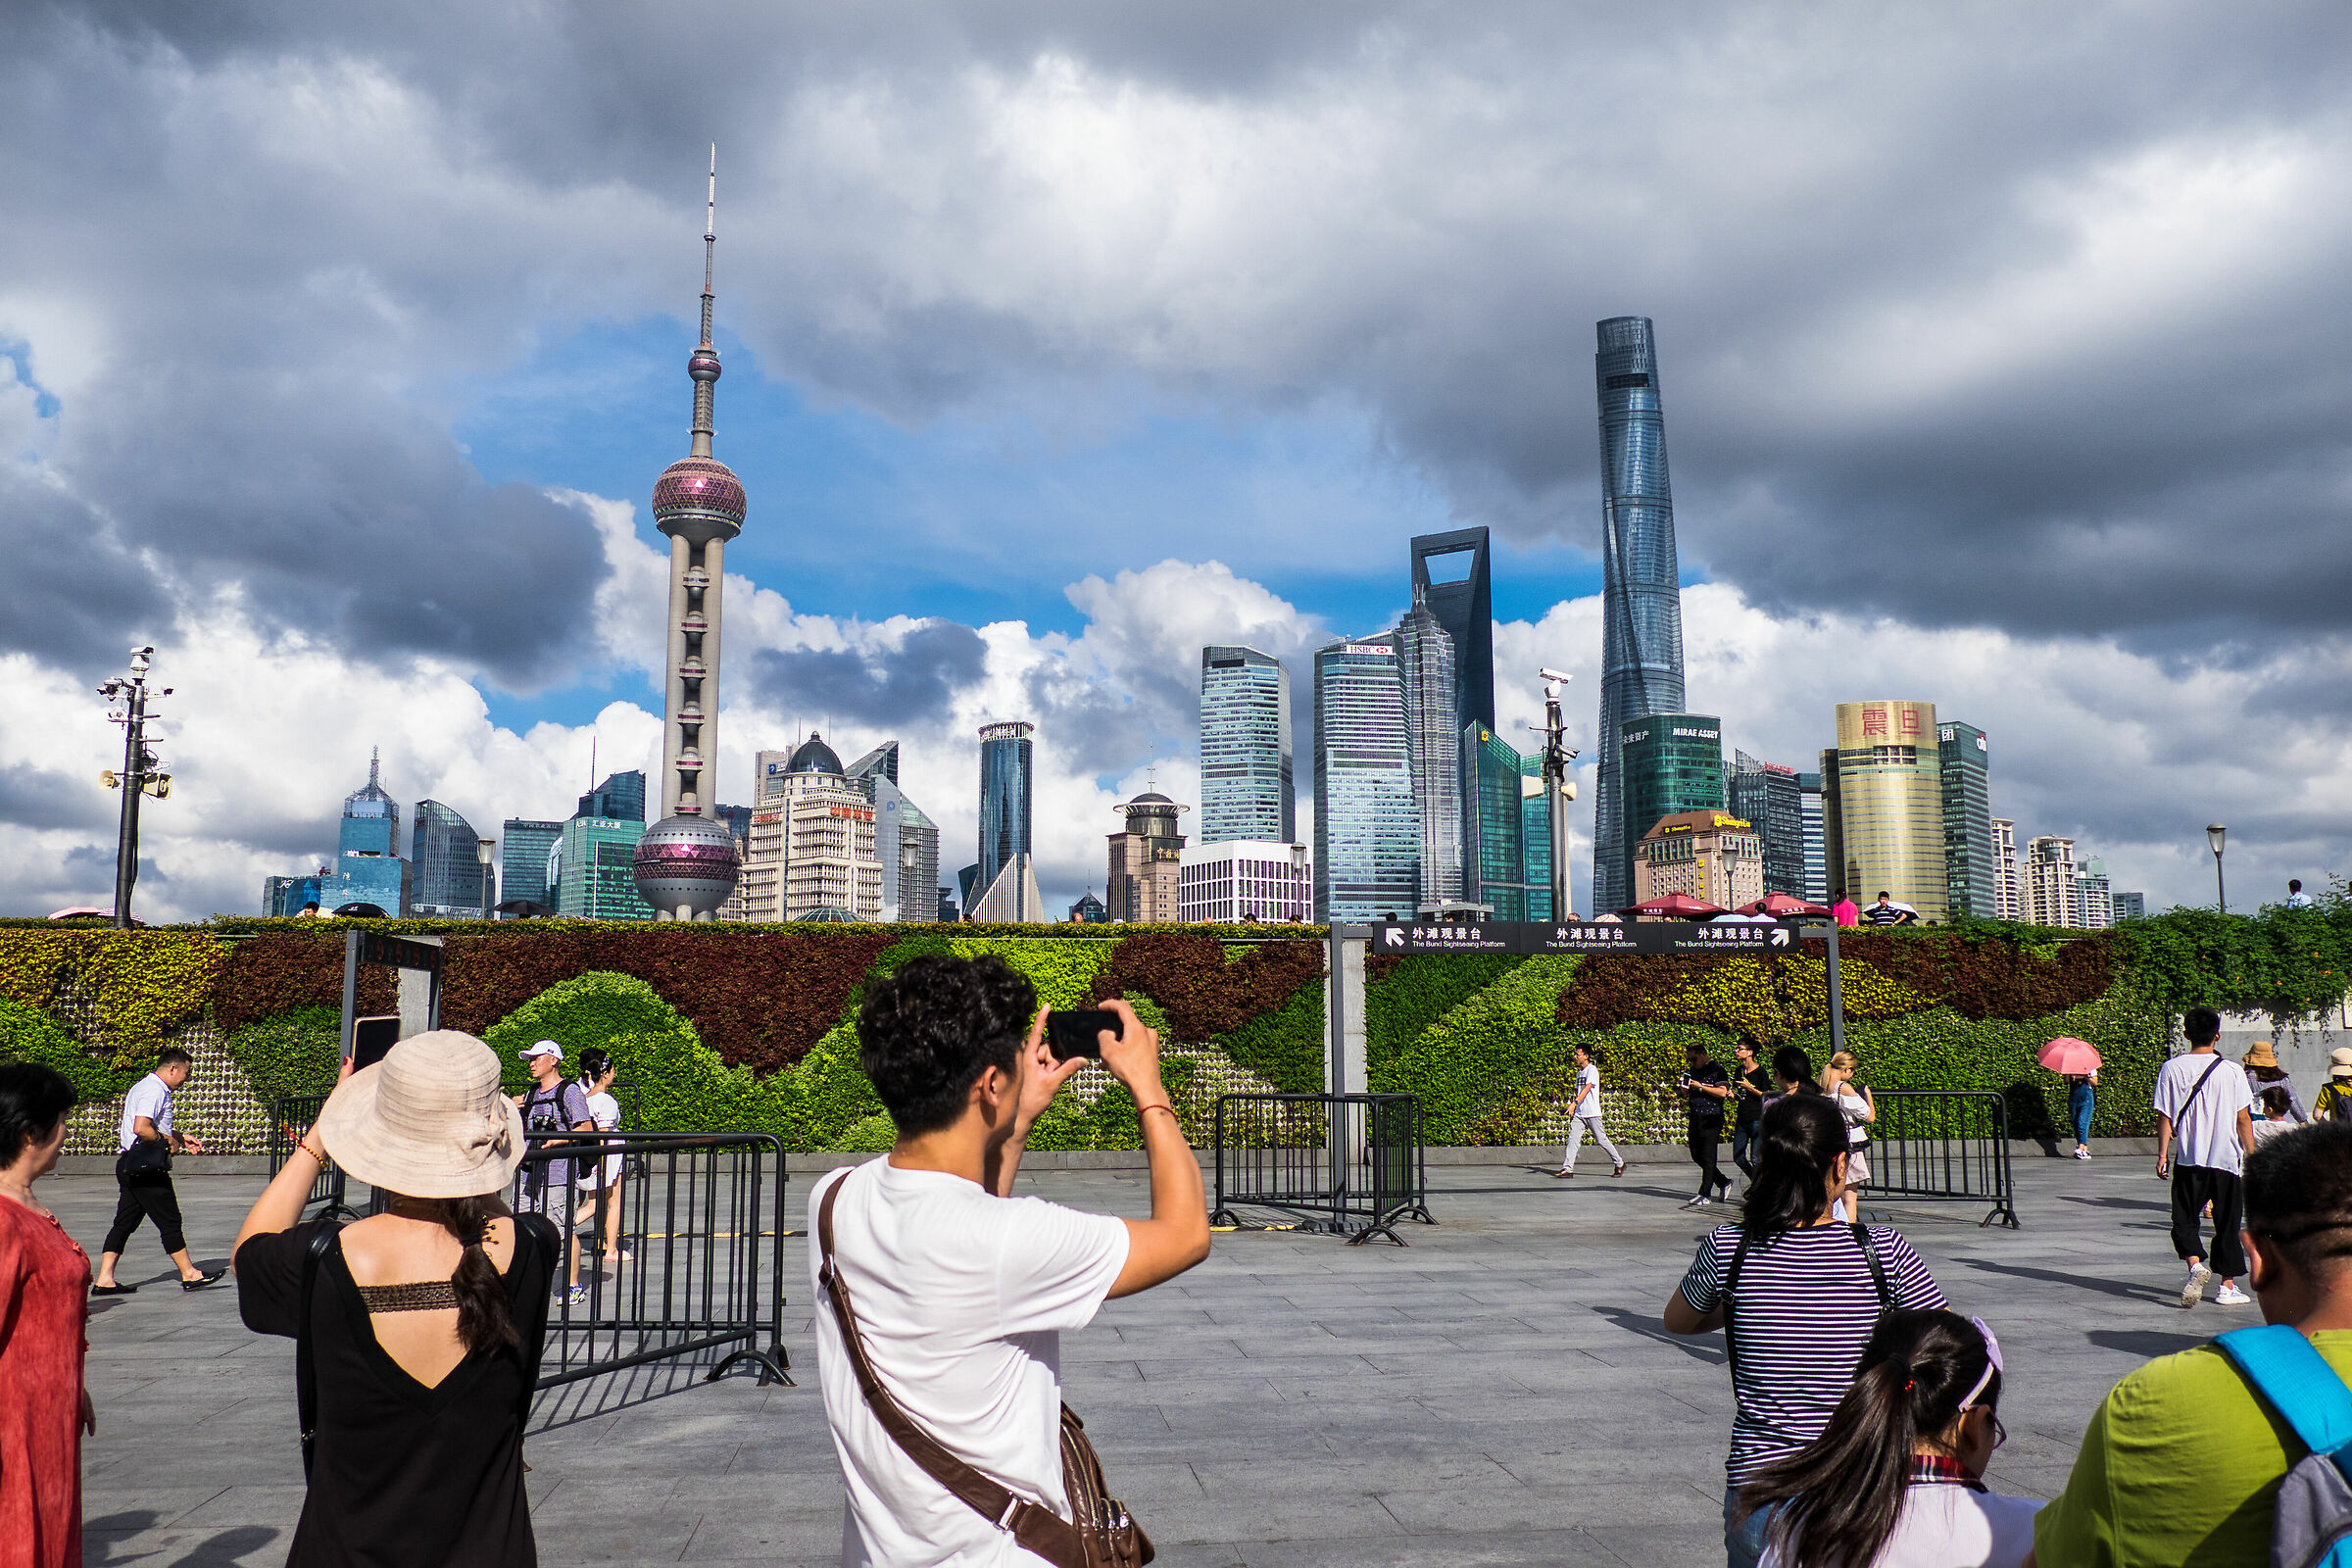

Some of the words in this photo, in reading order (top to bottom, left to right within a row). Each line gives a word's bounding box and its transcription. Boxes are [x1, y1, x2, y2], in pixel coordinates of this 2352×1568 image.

[1862, 709, 1921, 736] 震旦
[1672, 727, 1697, 737] MIRAE
[1697, 729, 1719, 739] ASSET
[1937, 729, 1954, 742] 团
[1412, 927, 1481, 940] 外滩观景台
[1556, 927, 1624, 940] 外滩观景台
[1697, 927, 1764, 940] 外滩观景台
